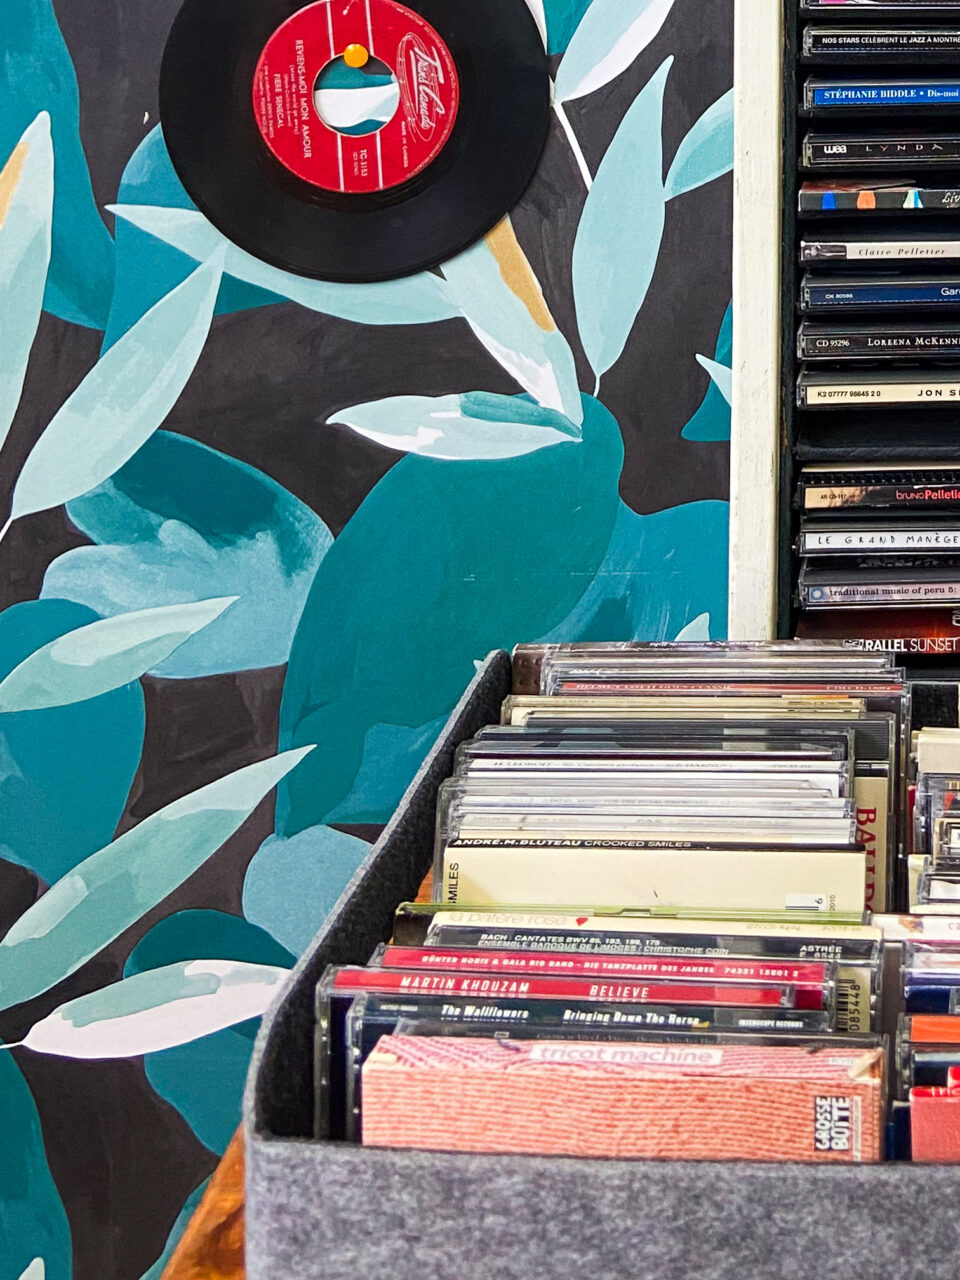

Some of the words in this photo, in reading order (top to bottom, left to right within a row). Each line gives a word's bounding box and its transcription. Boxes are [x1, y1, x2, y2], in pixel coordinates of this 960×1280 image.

[824, 88, 878, 99] STÉPHANIE
[880, 90, 917, 98] BIDDLE
[301, 98, 309, 121] MON
[302, 125, 311, 159] AMOUR
[917, 389, 943, 397] JON
[910, 638, 957, 651] SUNSET
[400, 976, 455, 992] MARTIN
[461, 978, 529, 993] KHOUZAM
[589, 984, 650, 999] BELIEVE
[539, 1045, 611, 1062] tricot
[616, 1047, 712, 1064] machine
[816, 1095, 830, 1150] GROSSE
